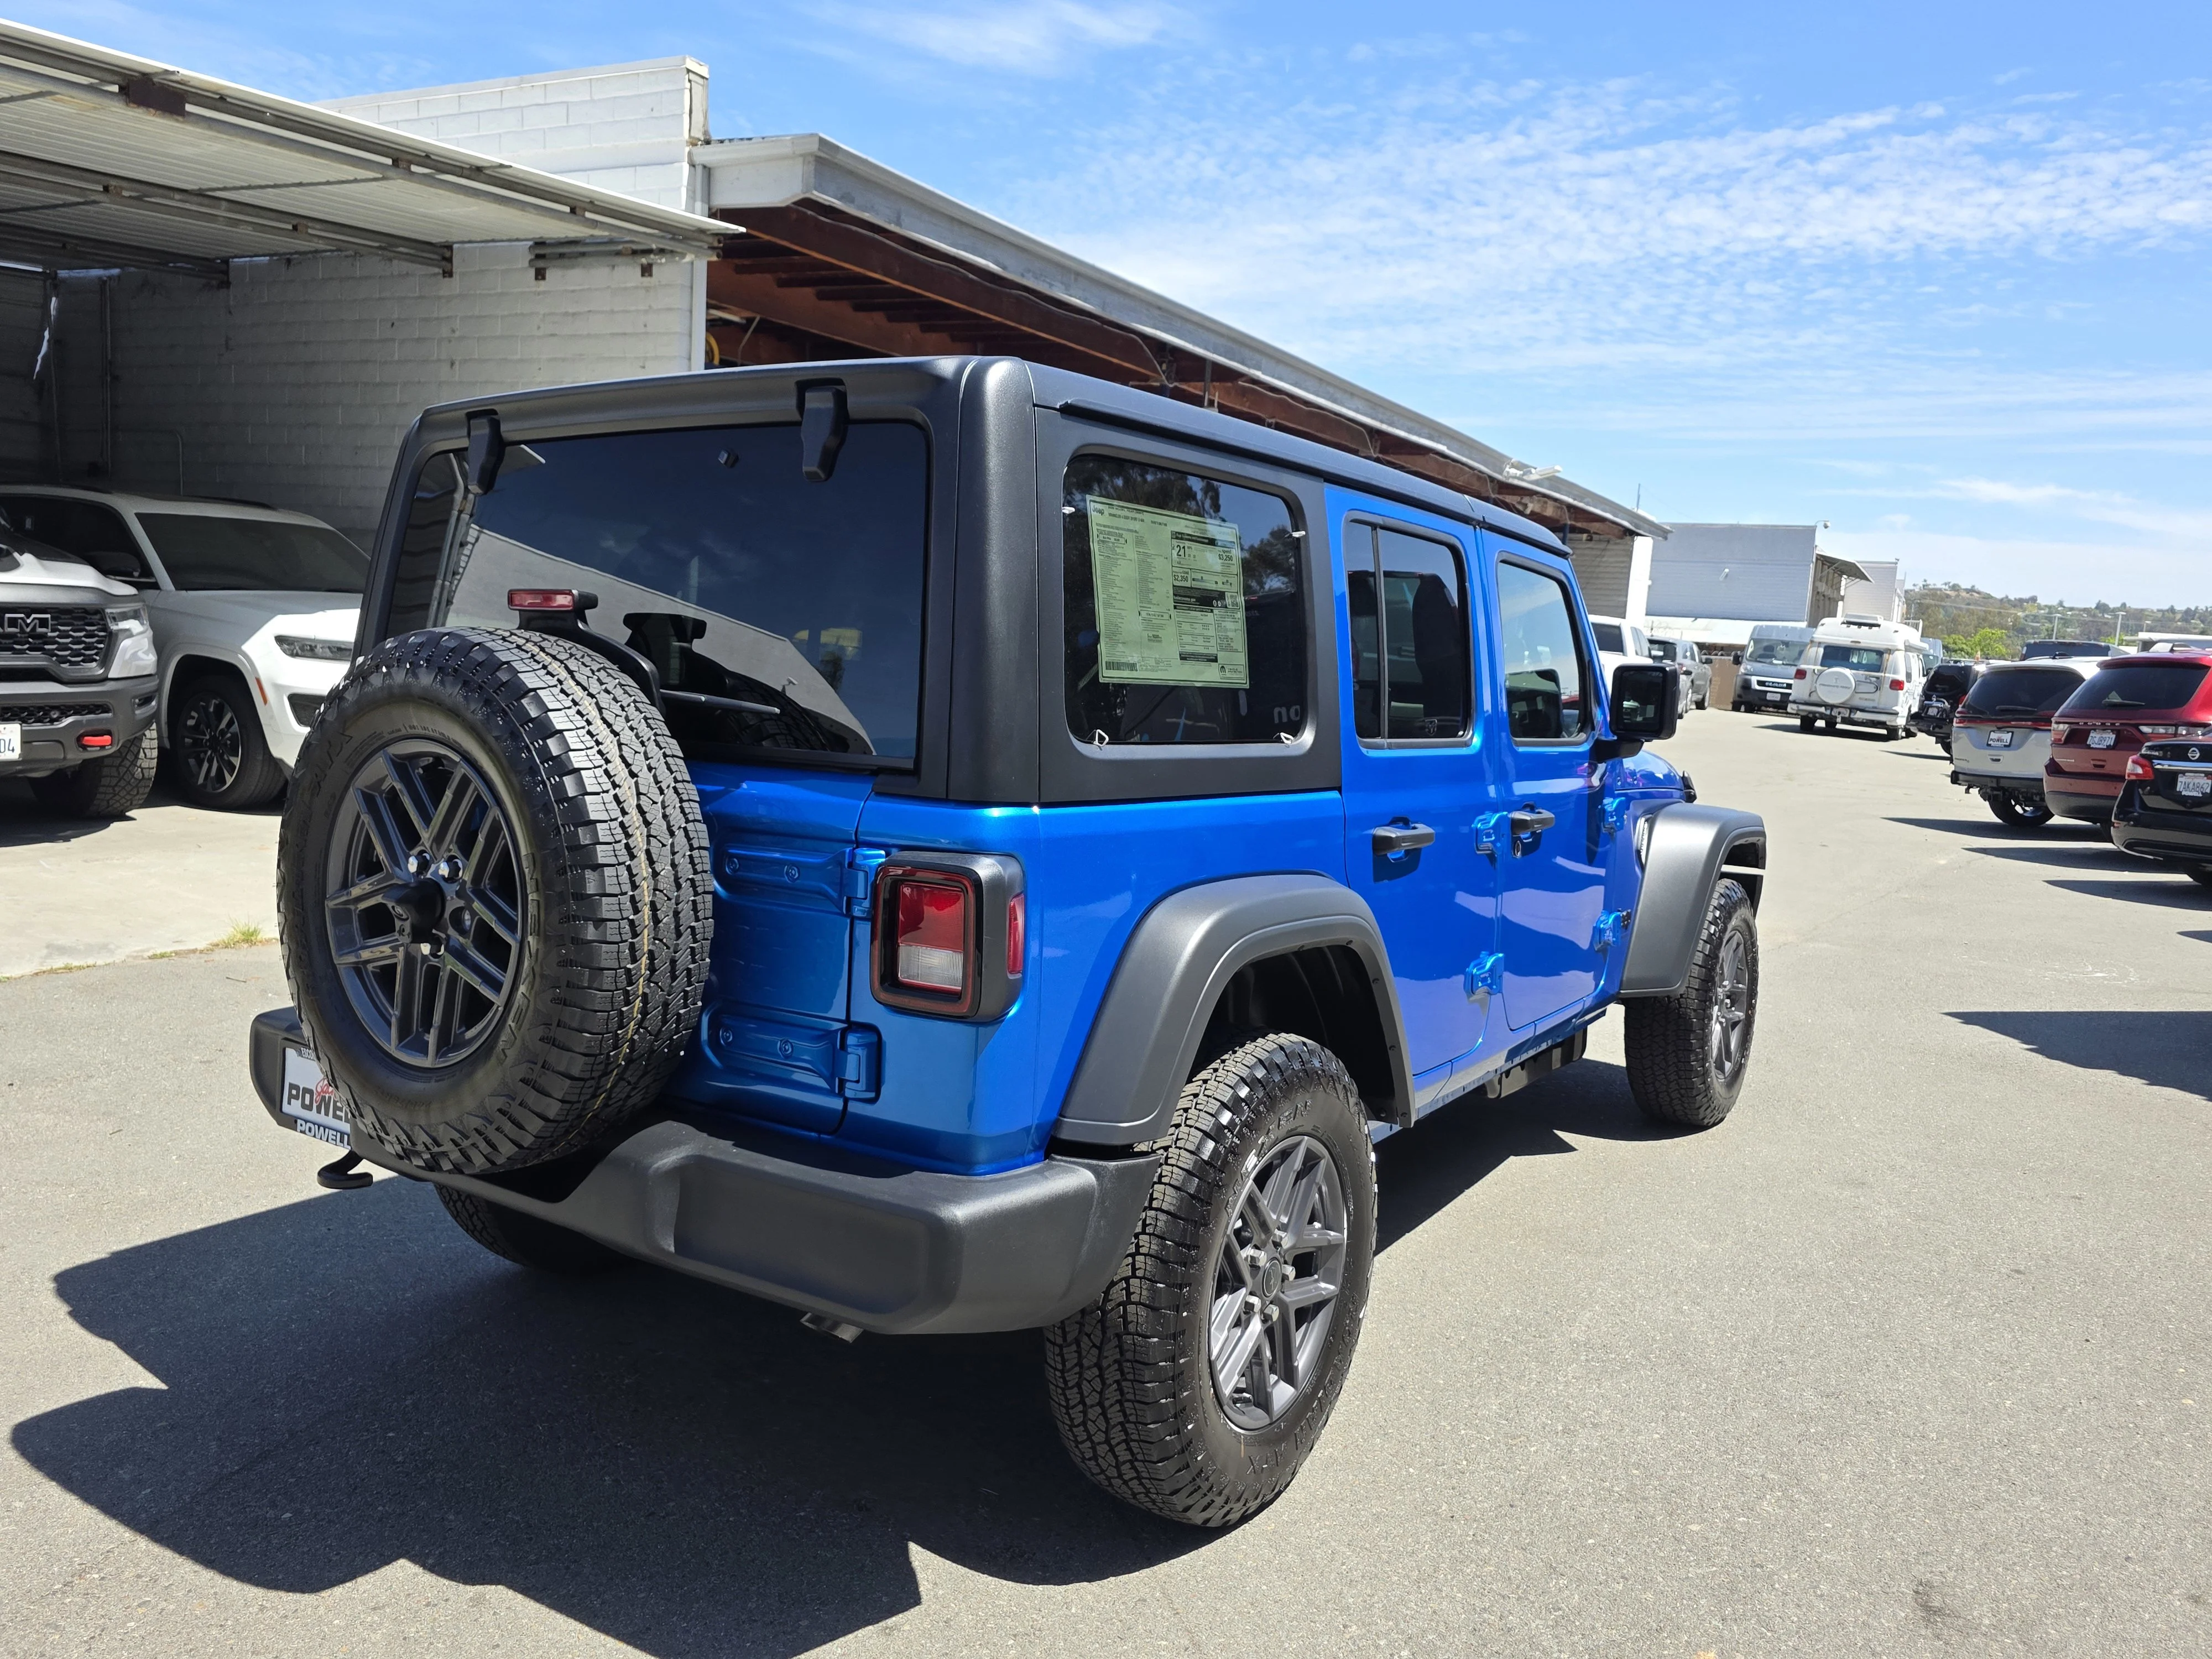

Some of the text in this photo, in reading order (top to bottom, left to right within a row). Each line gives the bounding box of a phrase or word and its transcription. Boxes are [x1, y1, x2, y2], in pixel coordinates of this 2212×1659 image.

[1092, 504, 1105, 516] Jeep
[1176, 544, 1186, 557] 21
[1218, 554, 1233, 562] $3,250
[1173, 574, 1189, 582] $2,350
[0, 613, 51, 633] M
[301, 1047, 315, 1060] ESCO
[296, 1119, 352, 1150] POWELL
